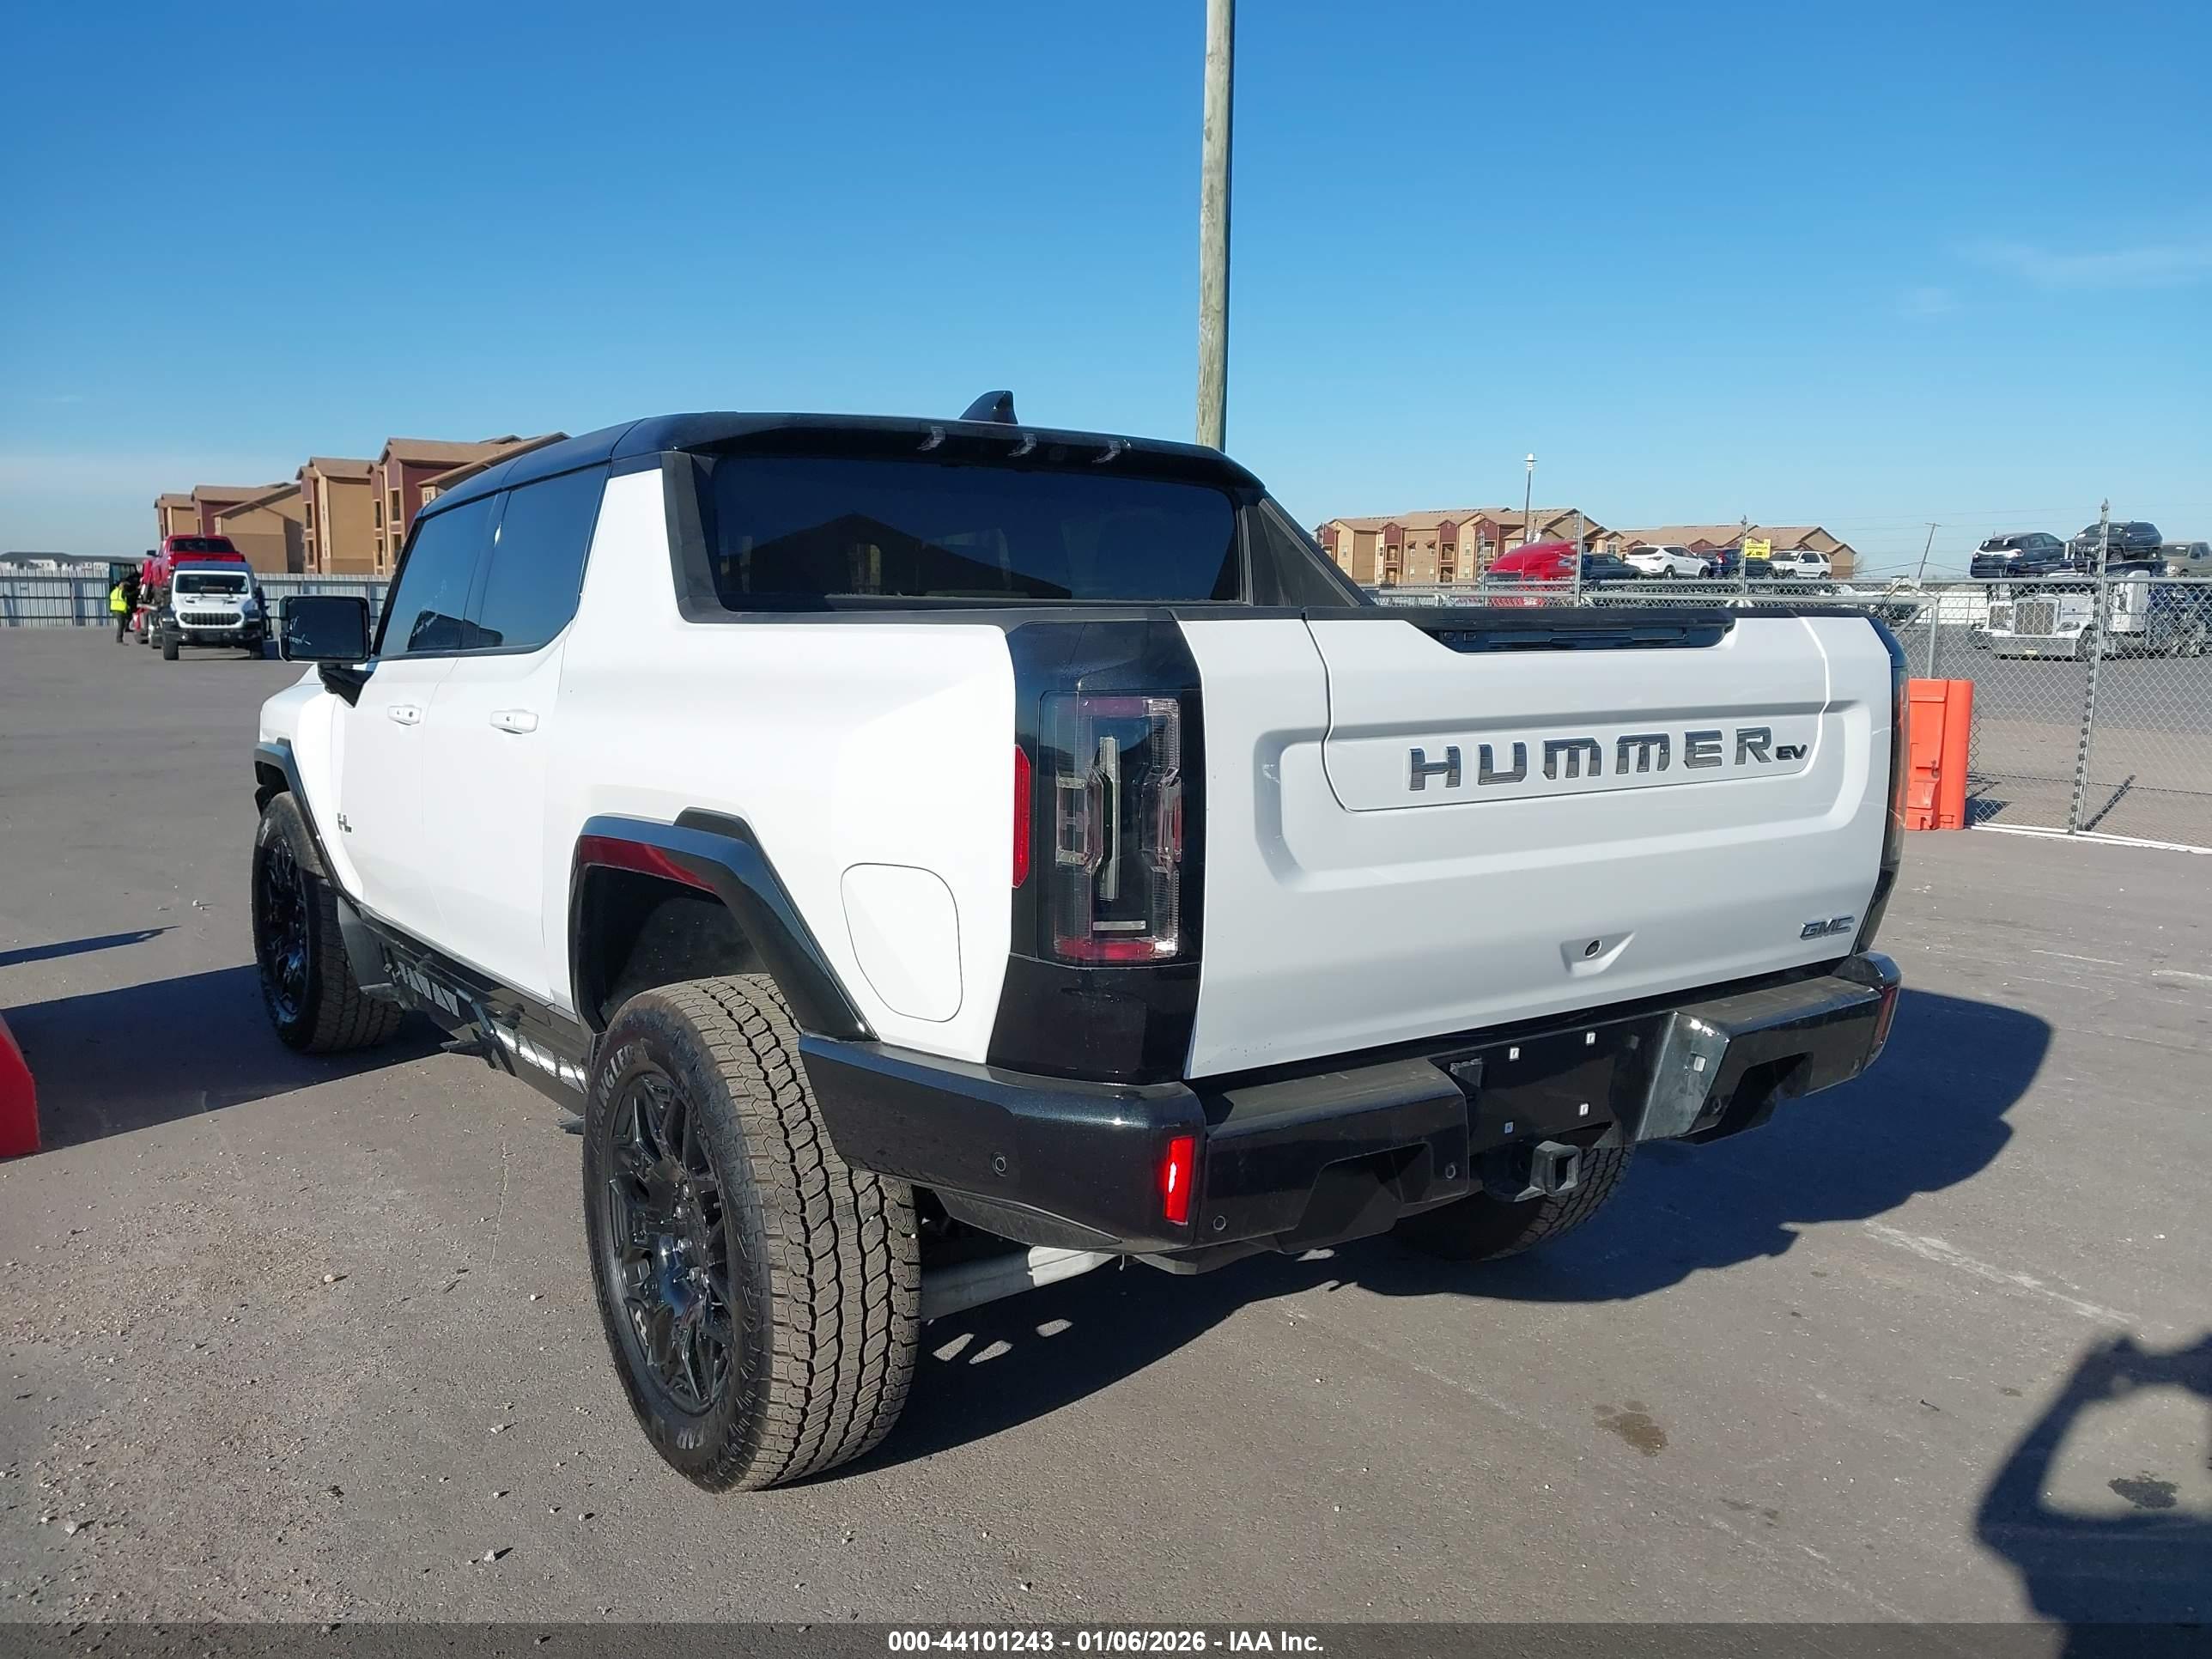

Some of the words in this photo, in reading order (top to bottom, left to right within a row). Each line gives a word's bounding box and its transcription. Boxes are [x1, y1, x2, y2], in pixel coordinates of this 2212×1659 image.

[1408, 726, 1772, 791] HUMMER
[1776, 744, 1808, 761] EV
[1800, 915, 1855, 940] GMC
